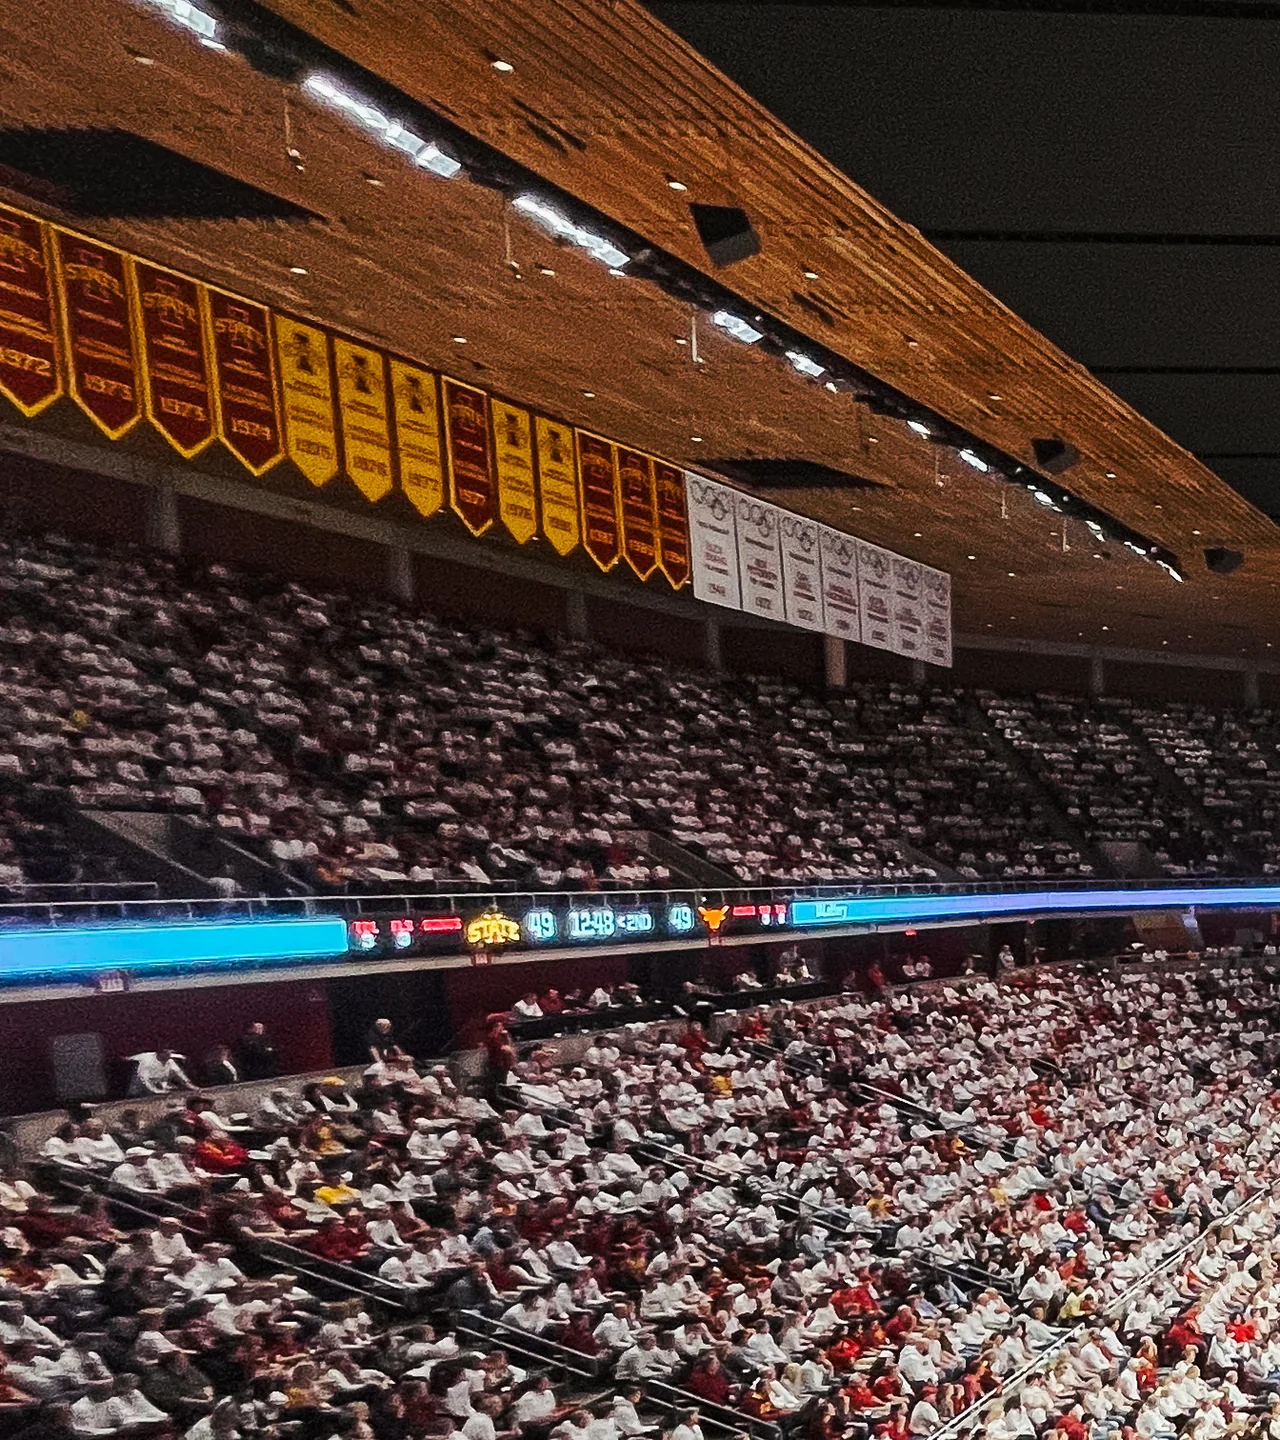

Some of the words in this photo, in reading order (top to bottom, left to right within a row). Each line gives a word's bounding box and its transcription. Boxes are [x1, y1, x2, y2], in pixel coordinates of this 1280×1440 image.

[466, 916, 521, 944] STATE
[528, 912, 556, 938] 49
[569, 910, 616, 938] 12:48
[671, 905, 693, 930] 49
